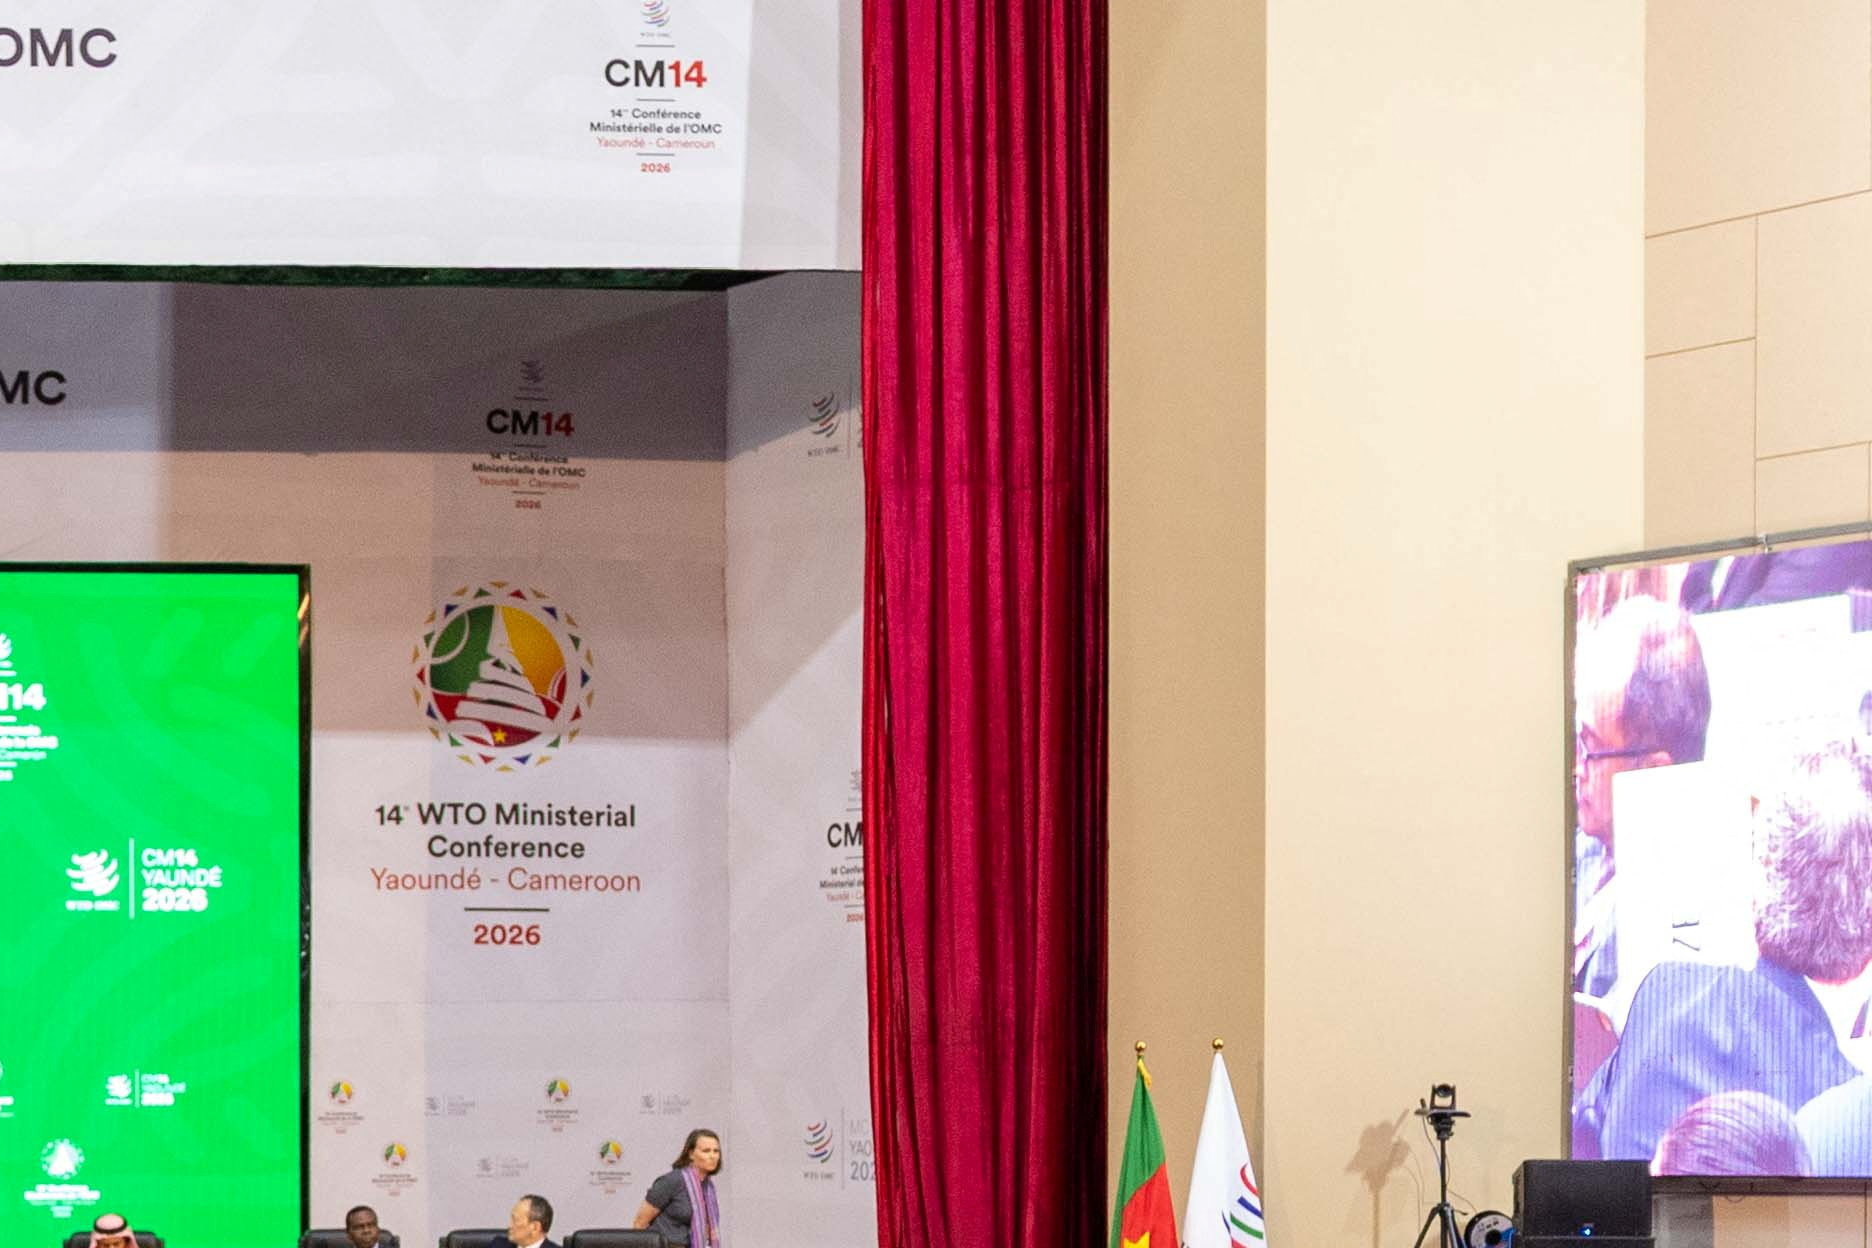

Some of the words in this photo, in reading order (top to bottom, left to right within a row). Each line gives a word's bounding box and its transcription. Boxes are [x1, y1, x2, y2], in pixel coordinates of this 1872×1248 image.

[604, 59, 708, 88] CM14
[632, 108, 702, 120] Conférence
[590, 122, 663, 134] Ministérielle
[666, 124, 681, 134] de
[640, 163, 671, 173] 2026
[486, 408, 576, 437] CM14
[417, 802, 486, 826] WTO
[495, 803, 636, 828] Ministerial
[428, 834, 586, 859] Conference
[827, 821, 863, 848] CM
[141, 847, 199, 867] CM14
[141, 864, 223, 888] YAUNDÉ
[369, 866, 481, 891] Yaoundé
[507, 867, 642, 892] Cameroon
[141, 887, 209, 911] 2026
[473, 923, 541, 946] 2026
